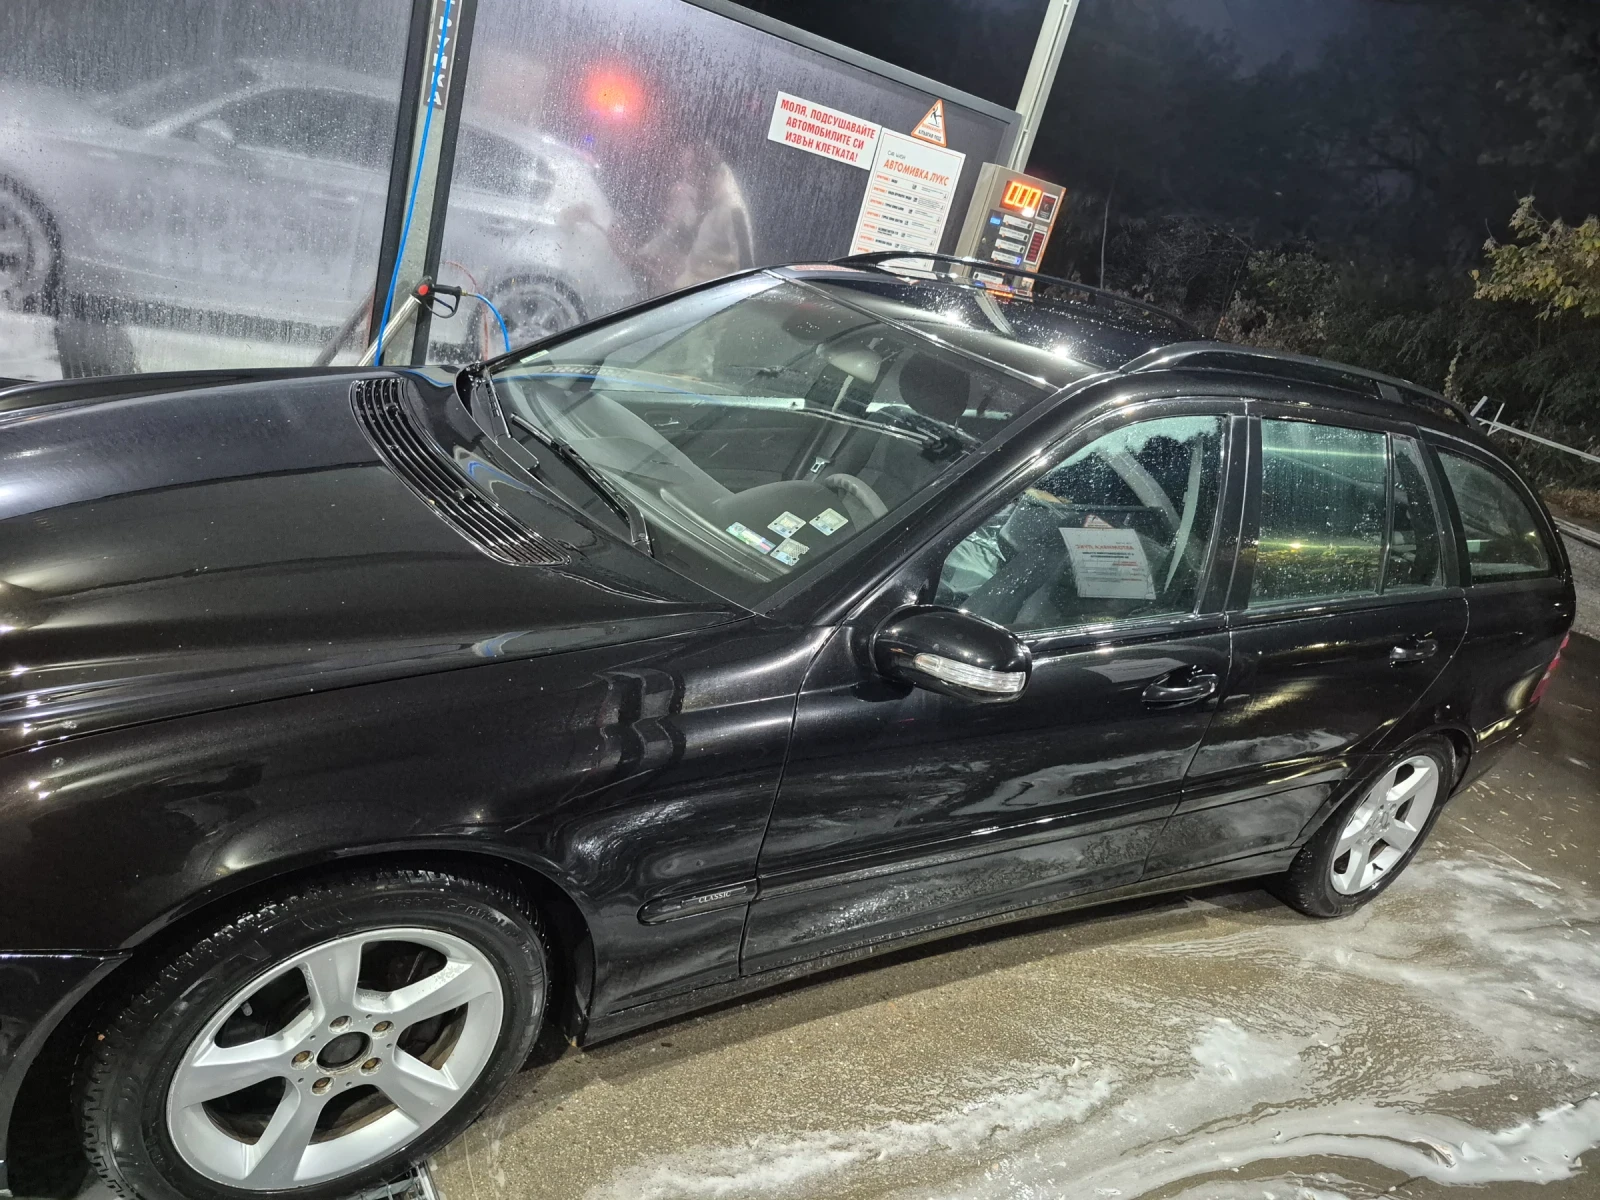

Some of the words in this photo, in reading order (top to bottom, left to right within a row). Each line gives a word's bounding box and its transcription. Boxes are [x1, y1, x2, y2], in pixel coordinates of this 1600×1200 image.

[780, 99, 808, 117] МОЛЯ,
[810, 108, 876, 139] ПОДСУШАВАЙТЕ
[786, 116, 852, 146] АВТОМОБИЛИТЕ
[852, 138, 865, 150] СИ
[785, 131, 814, 148] ИЗВЪН
[815, 141, 859, 162] КЛЕТКАТА!
[883, 158, 929, 181] АВТОМИВКА
[929, 172, 950, 186] ЛУКС
[698, 891, 732, 904] CLASSIC
